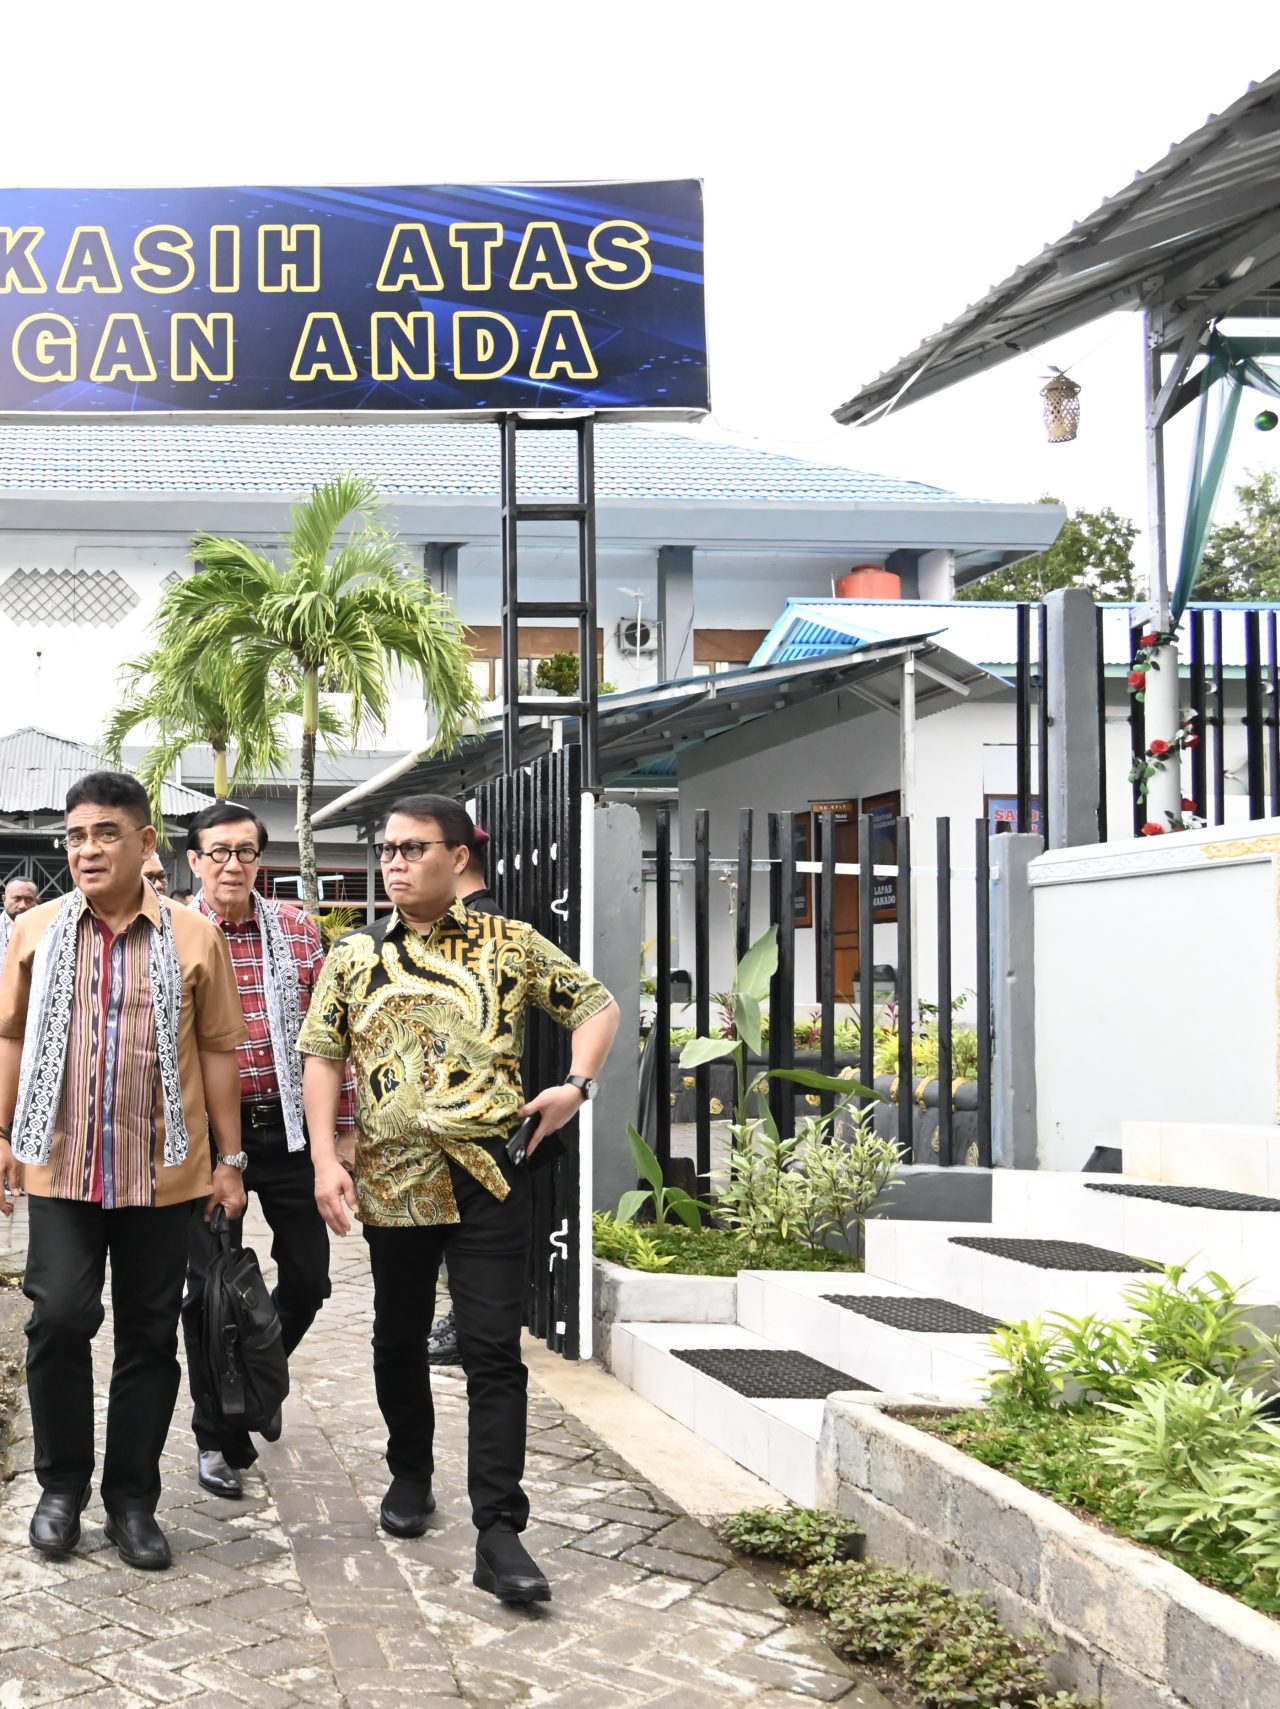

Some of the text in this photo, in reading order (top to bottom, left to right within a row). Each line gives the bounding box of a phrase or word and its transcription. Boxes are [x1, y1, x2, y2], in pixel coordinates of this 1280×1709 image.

[376, 220, 652, 292] ATAS
[289, 310, 599, 382] ANDA
[873, 884, 893, 896] LAPAS
